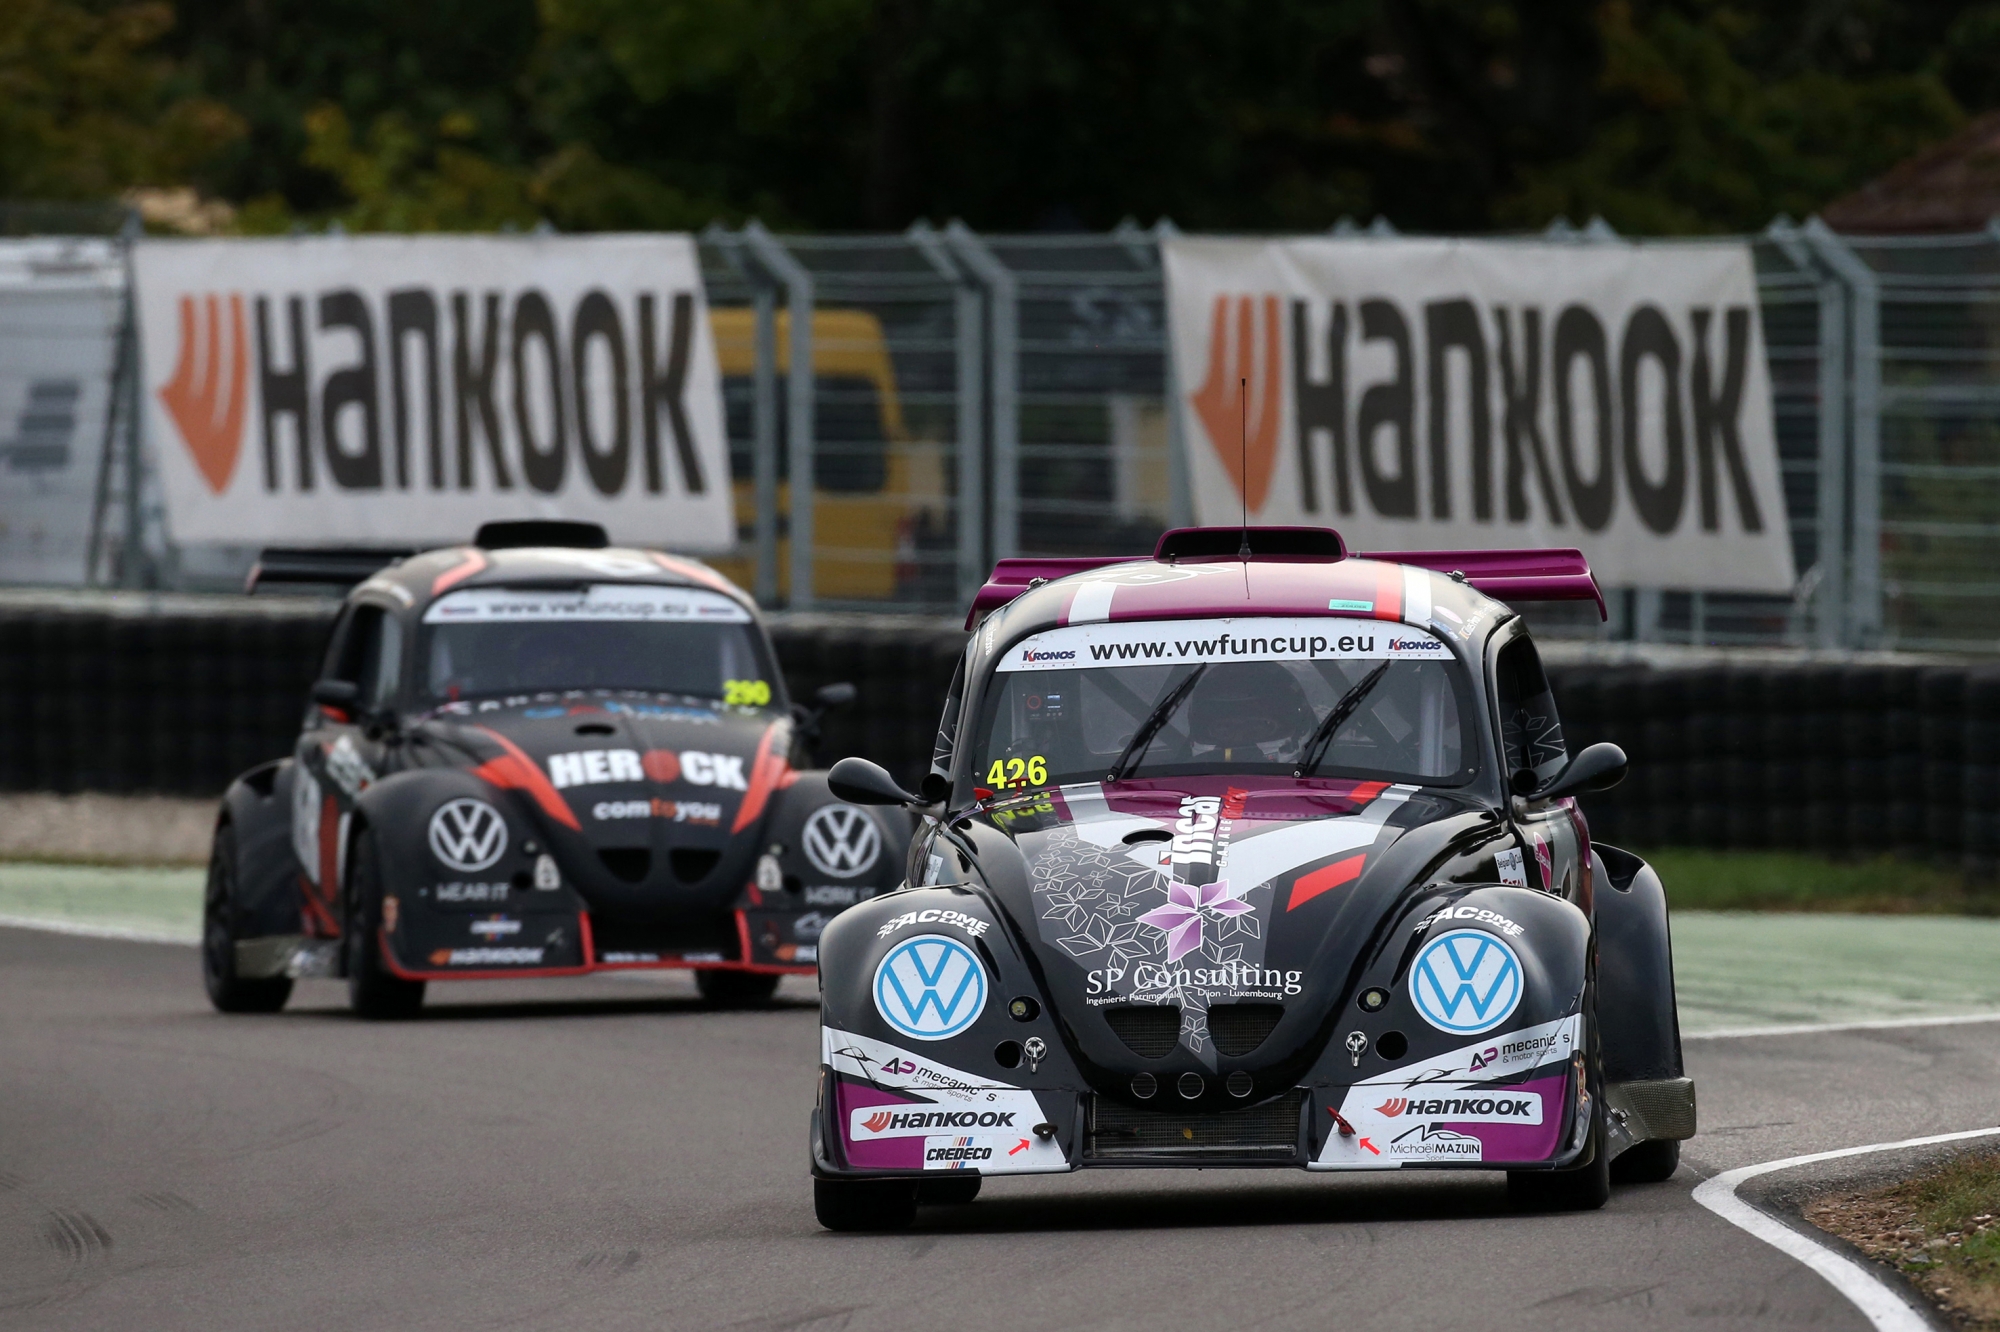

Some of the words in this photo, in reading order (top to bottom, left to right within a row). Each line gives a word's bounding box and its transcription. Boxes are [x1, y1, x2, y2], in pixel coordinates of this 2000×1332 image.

[1090, 633, 1374, 660] www.vwfuncup.eu
[1388, 636, 1442, 651] KRONOS
[1022, 647, 1076, 662] KRONOS
[986, 755, 1048, 790] 426
[1216, 819, 1232, 868] GARAGE
[1086, 968, 1124, 994] SP
[1133, 961, 1302, 995] Consulting
[1197, 989, 1221, 999] Dijon
[1229, 989, 1283, 1000] Luxembourg
[1511, 1051, 1535, 1062] motor
[946, 1088, 974, 1102] sports
[926, 1146, 993, 1161] CREDECO
[1426, 1154, 1445, 1162] Sport
